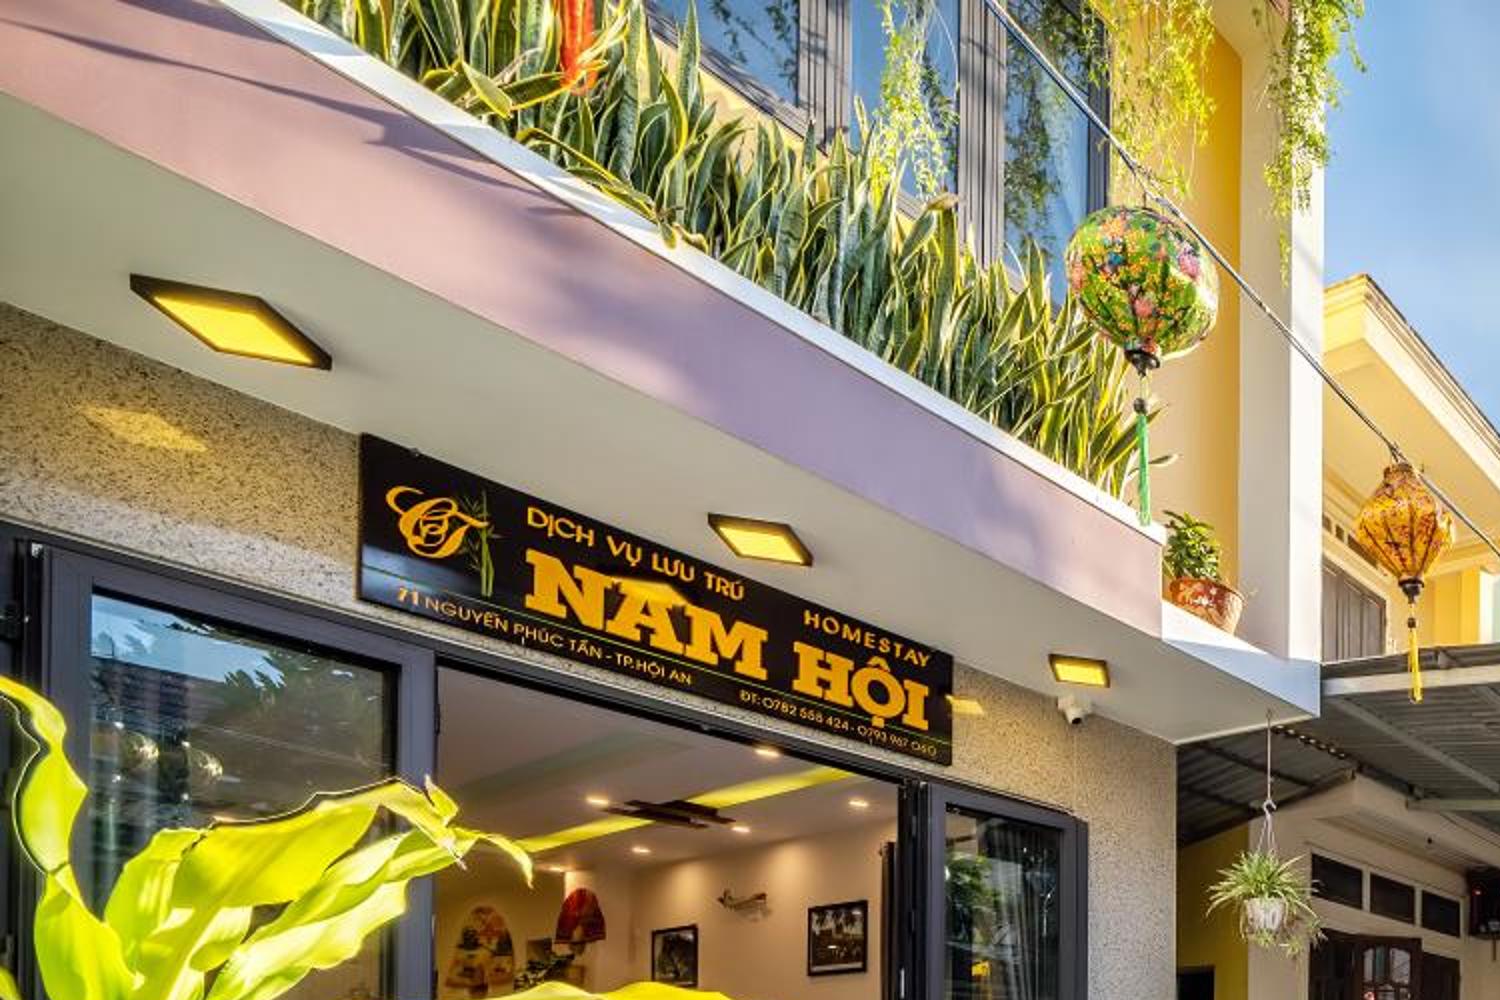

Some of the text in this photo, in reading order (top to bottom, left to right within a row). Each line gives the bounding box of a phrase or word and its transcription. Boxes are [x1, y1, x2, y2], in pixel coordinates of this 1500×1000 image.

[527, 506, 596, 547] DỊCH
[606, 535, 643, 568] VỤ
[651, 552, 695, 583] LƯU
[703, 570, 745, 601] TRÚ
[397, 585, 420, 607] 71
[513, 622, 564, 648] PHÚC
[668, 669, 693, 686] AN
[525, 549, 930, 731] NAM HỘI
[802, 609, 931, 669] HOMESTAY
